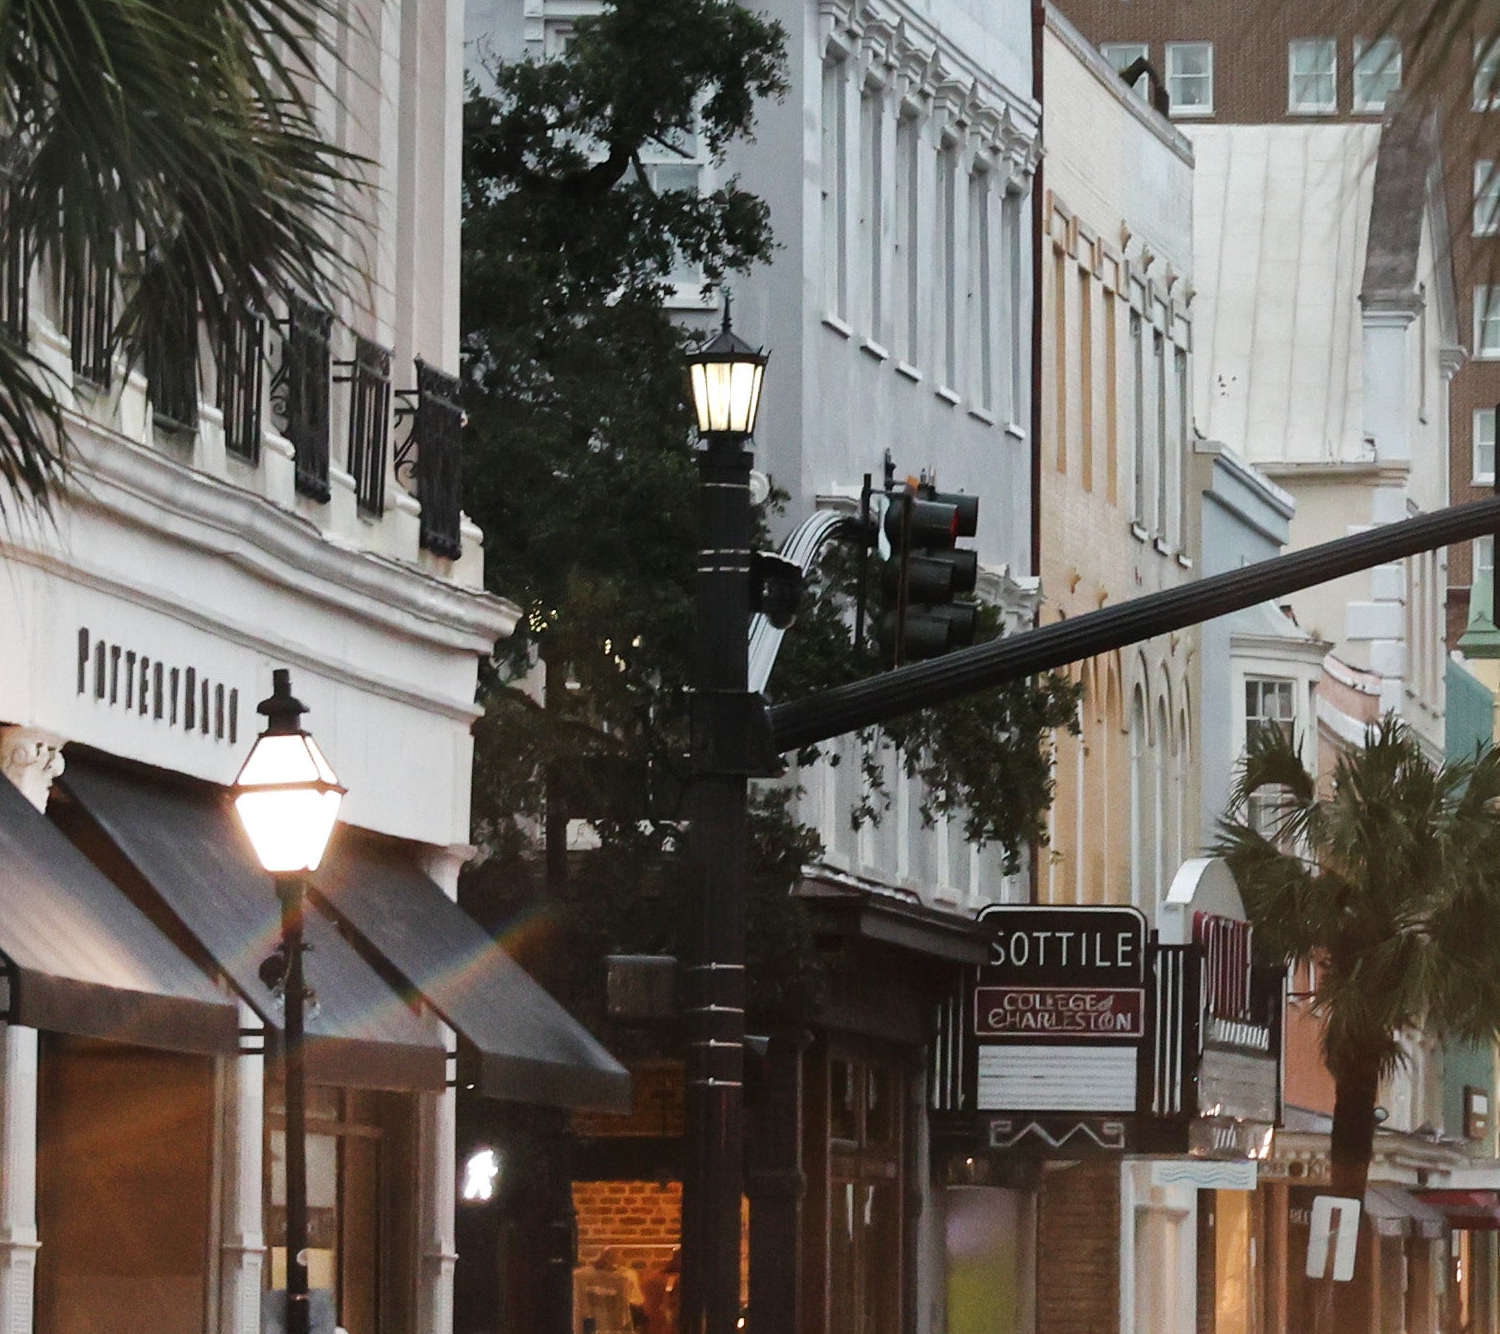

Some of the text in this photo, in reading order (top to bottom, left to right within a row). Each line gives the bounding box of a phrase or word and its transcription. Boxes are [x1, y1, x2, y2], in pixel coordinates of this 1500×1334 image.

[990, 931, 1133, 967] SOTTILE
[1002, 992, 1097, 1011] COLLEGE
[987, 1008, 1133, 1032] CHARLESTON
